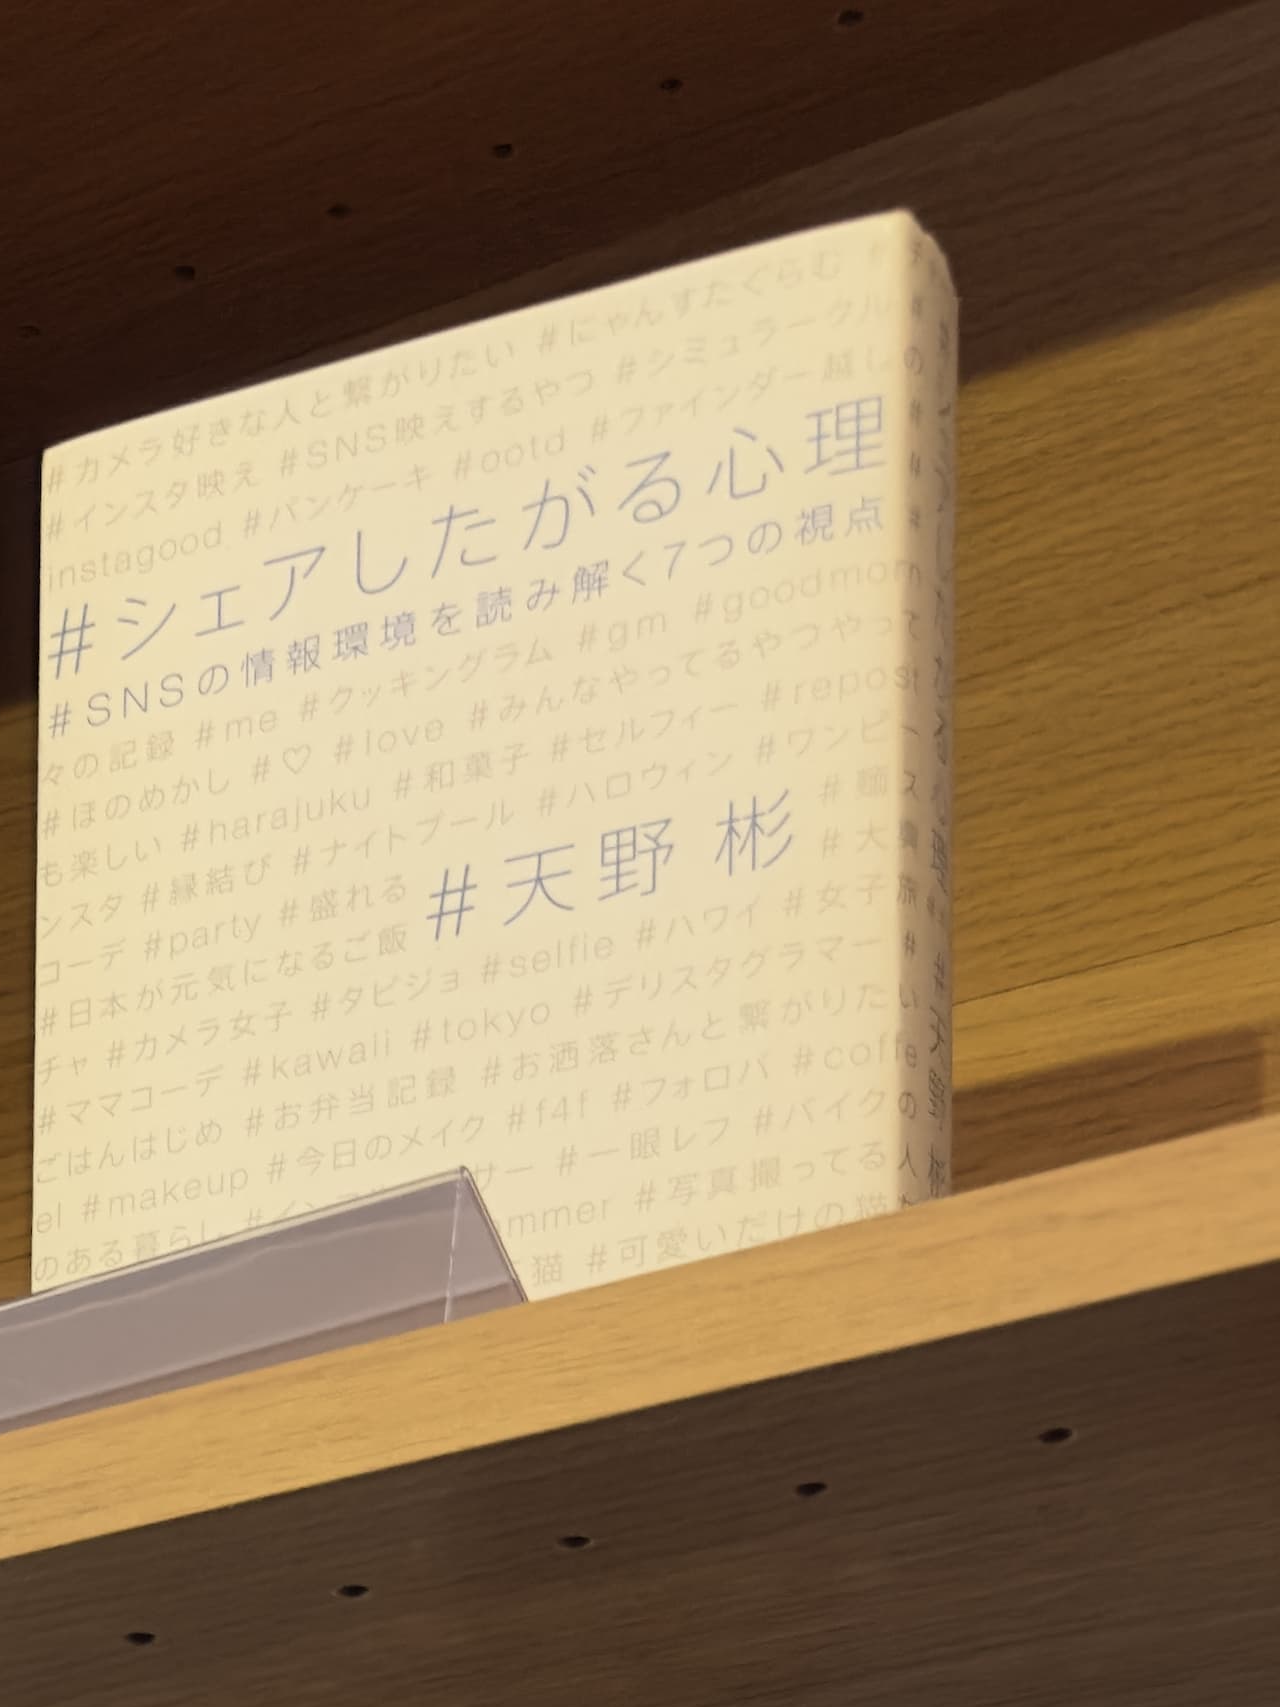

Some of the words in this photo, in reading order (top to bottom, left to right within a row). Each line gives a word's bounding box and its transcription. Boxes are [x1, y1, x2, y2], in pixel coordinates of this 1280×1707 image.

[50, 394, 889, 680] #シェアしたがる心理
[50, 496, 884, 737] #SNSの情報環境を読み解く7つの視点
[195, 709, 279, 751] #me
[577, 614, 667, 652] #gm
[181, 788, 371, 852] #harajuku
[393, 740, 530, 800] #和菓子
[551, 698, 741, 763] #セルフィー
[333, 717, 445, 763] #love
[140, 852, 273, 913] #縁結び
[536, 751, 733, 818] #ハロウィン
[143, 913, 261, 960] #party
[279, 874, 407, 927] #盛れる
[425, 817, 675, 941] #天野
[714, 788, 794, 877] 彬
[44, 927, 408, 1034] #日本が元気になるご飯
[104, 1000, 292, 1071] #カメラ女子
[311, 968, 460, 1021] #タビジョ
[479, 931, 616, 984] #selfie
[635, 900, 761, 947] #ハワイ
[40, 1062, 225, 1131] #ママコーデ
[240, 1031, 391, 1087] #kawaii
[410, 1000, 551, 1052] #tokyo
[80, 1167, 249, 1222] #makeup
[266, 1113, 486, 1186] #今日のメイク
[506, 1089, 587, 1138] #f4f
[612, 1054, 769, 1113] #フォロバ
[245, 1065, 457, 1138] #お弁当記録
[556, 1116, 731, 1176] #一眼レフ
